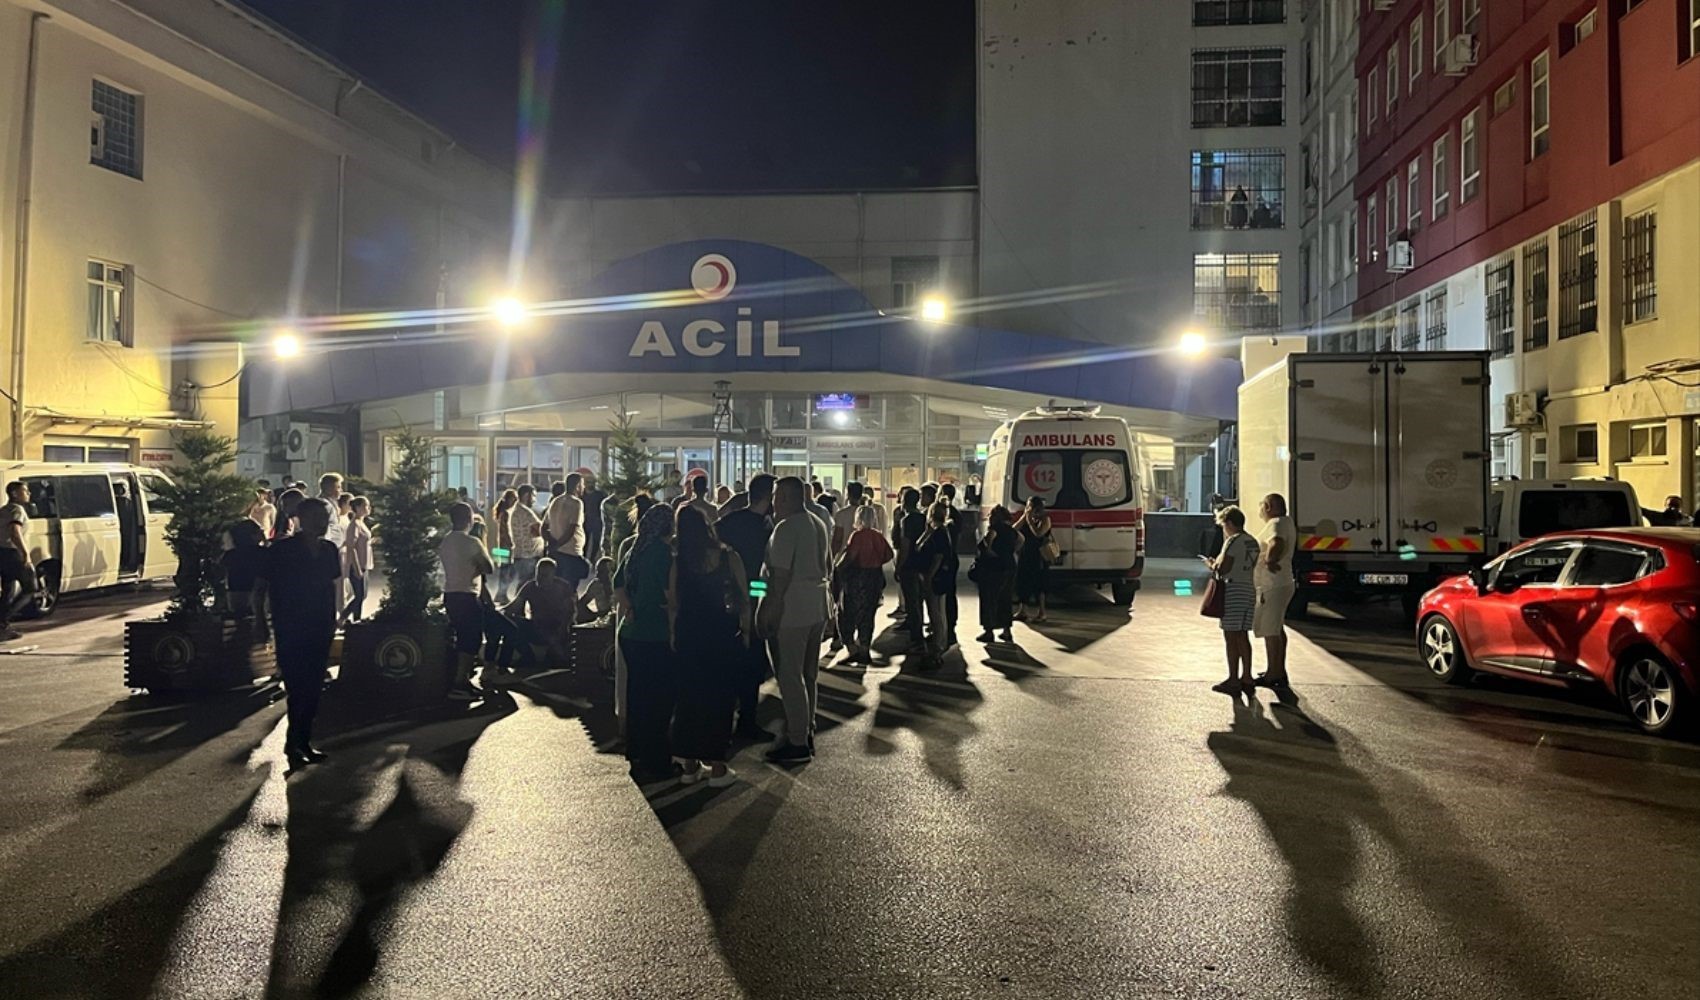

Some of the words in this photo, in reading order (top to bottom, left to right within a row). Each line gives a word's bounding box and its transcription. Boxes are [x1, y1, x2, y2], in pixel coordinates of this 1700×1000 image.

[629, 307, 800, 357] ACİL
[1023, 434, 1116, 446] AMBULANS
[1034, 470, 1056, 482] 112
